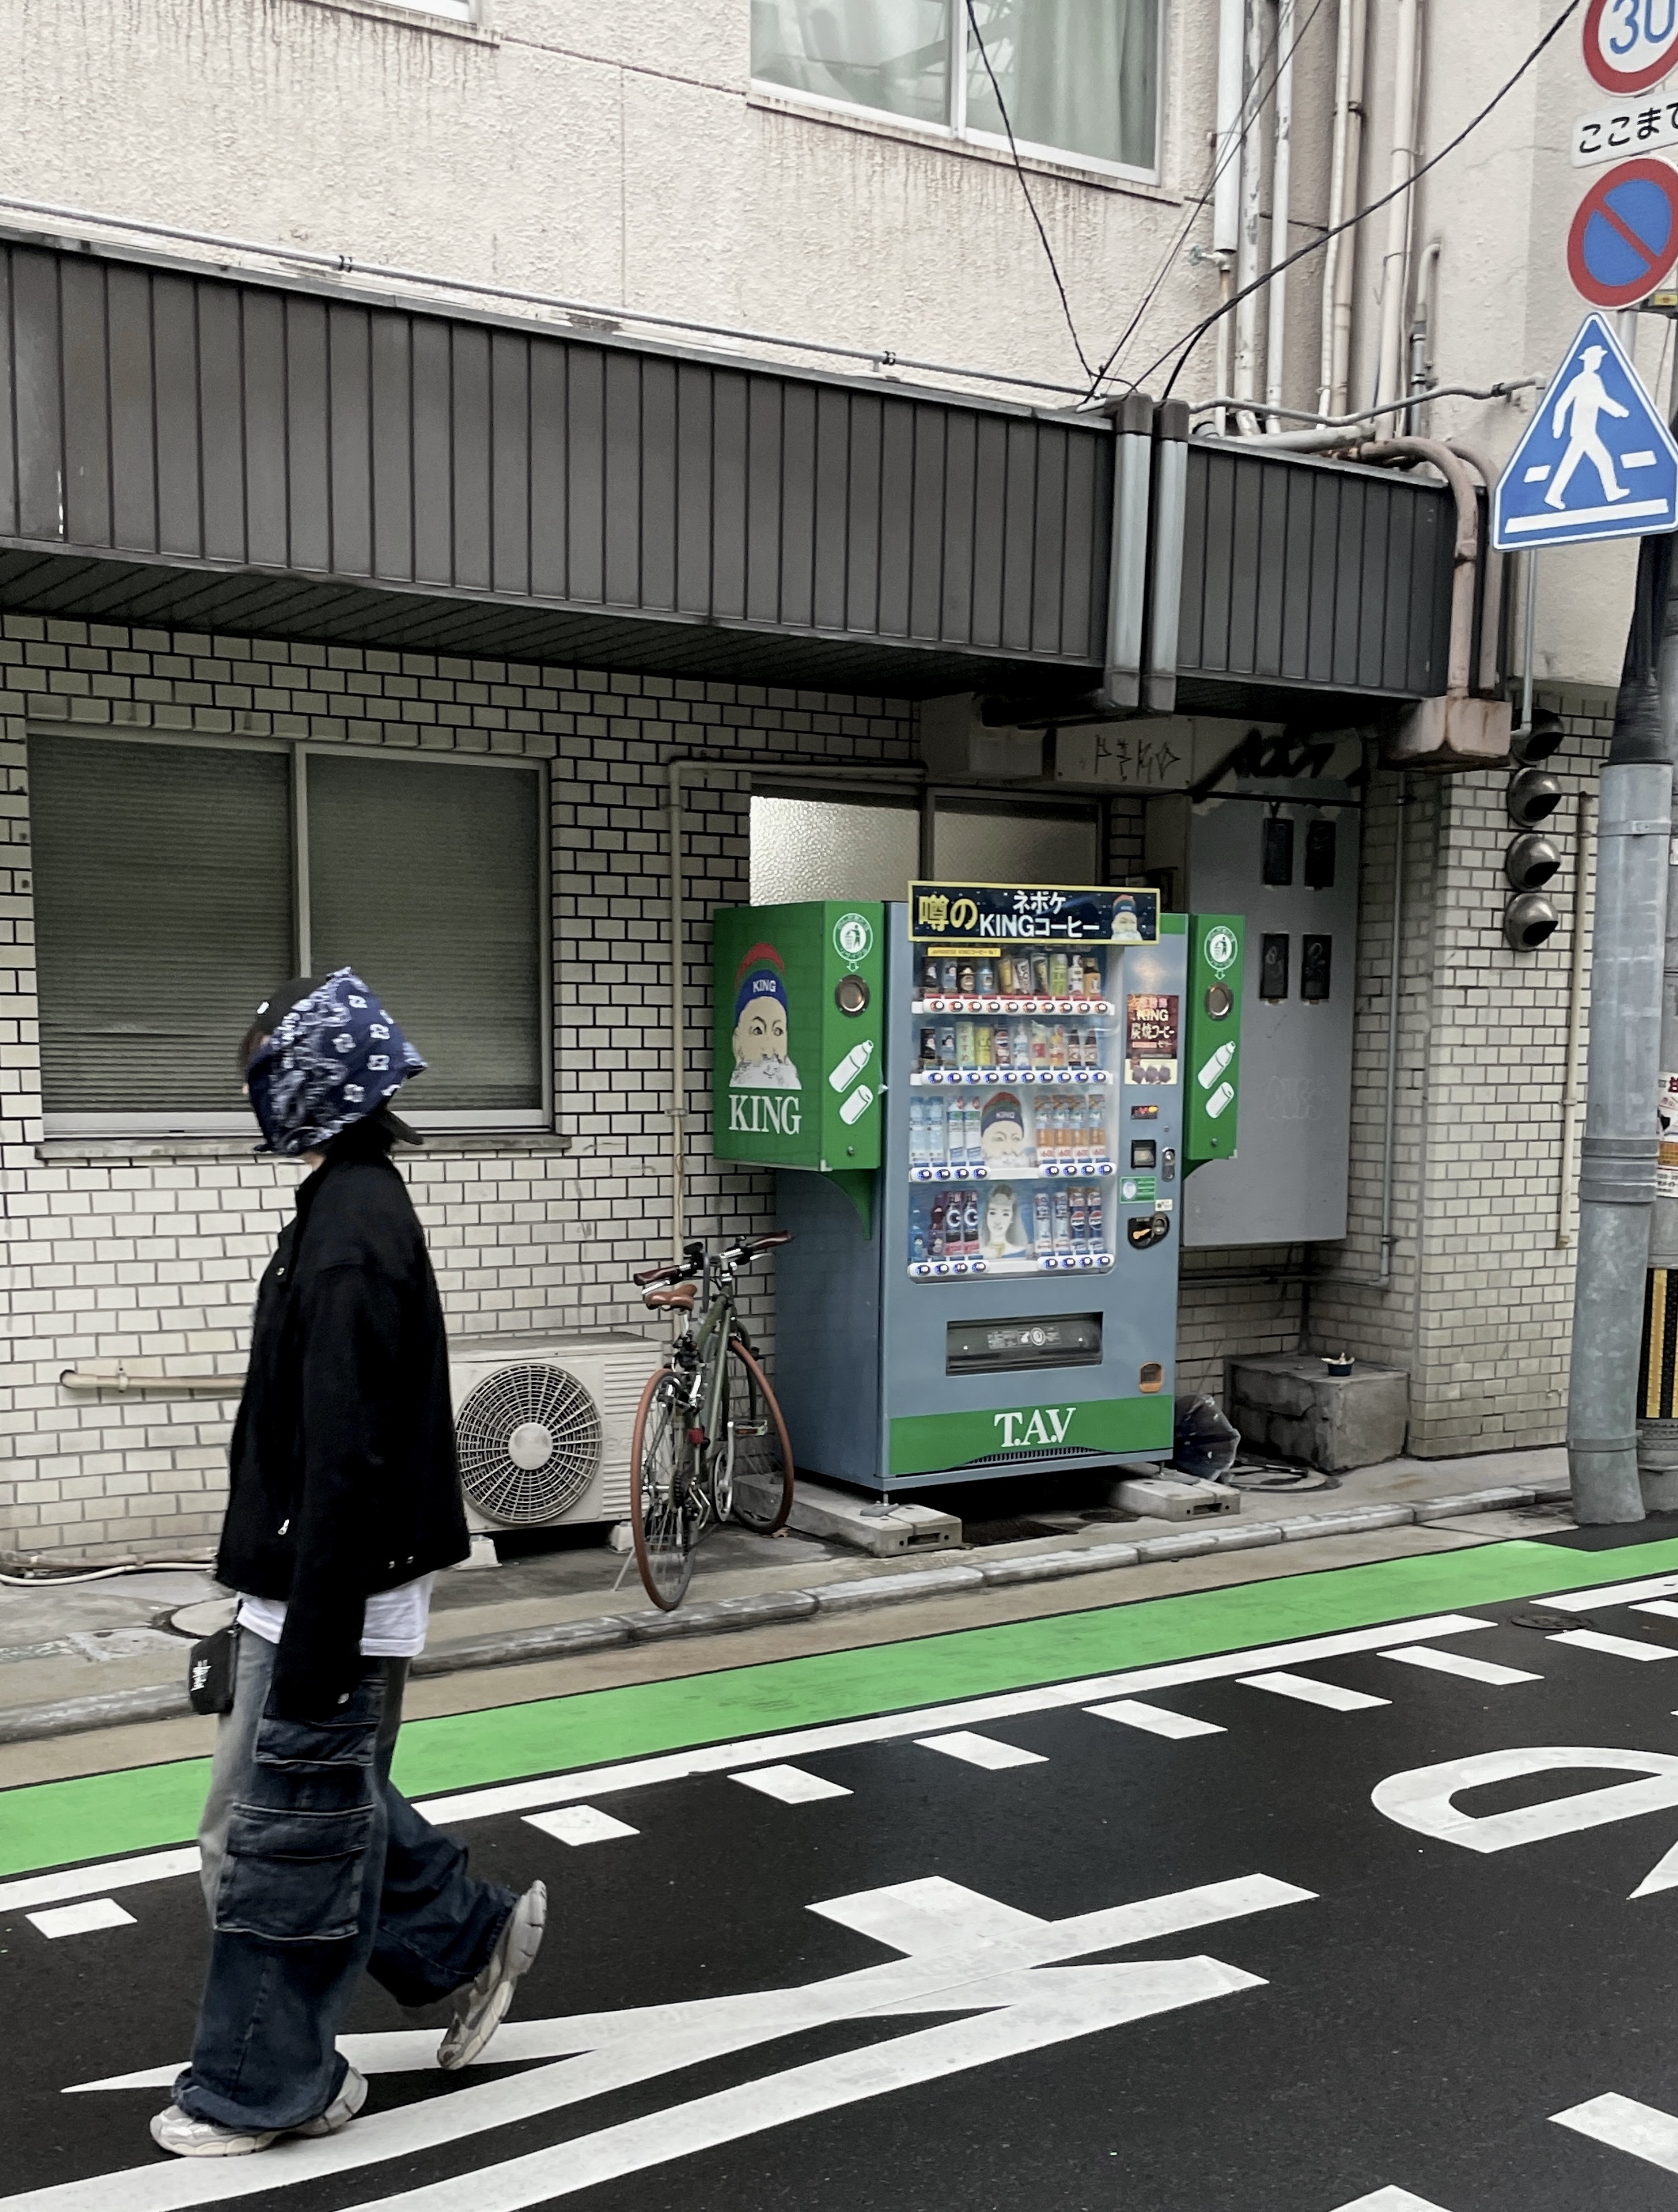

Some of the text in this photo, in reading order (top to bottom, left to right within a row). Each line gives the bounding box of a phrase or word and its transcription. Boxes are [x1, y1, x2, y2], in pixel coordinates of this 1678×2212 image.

[1609, 0, 1675, 55] 30
[918, 894, 978, 932] 噂の
[1013, 890, 1066, 915] ネボケ
[980, 913, 1100, 937] KINGコーヒー
[752, 979, 776, 993] KING
[1136, 1008, 1169, 1022] KING
[728, 1094, 803, 1135] KING
